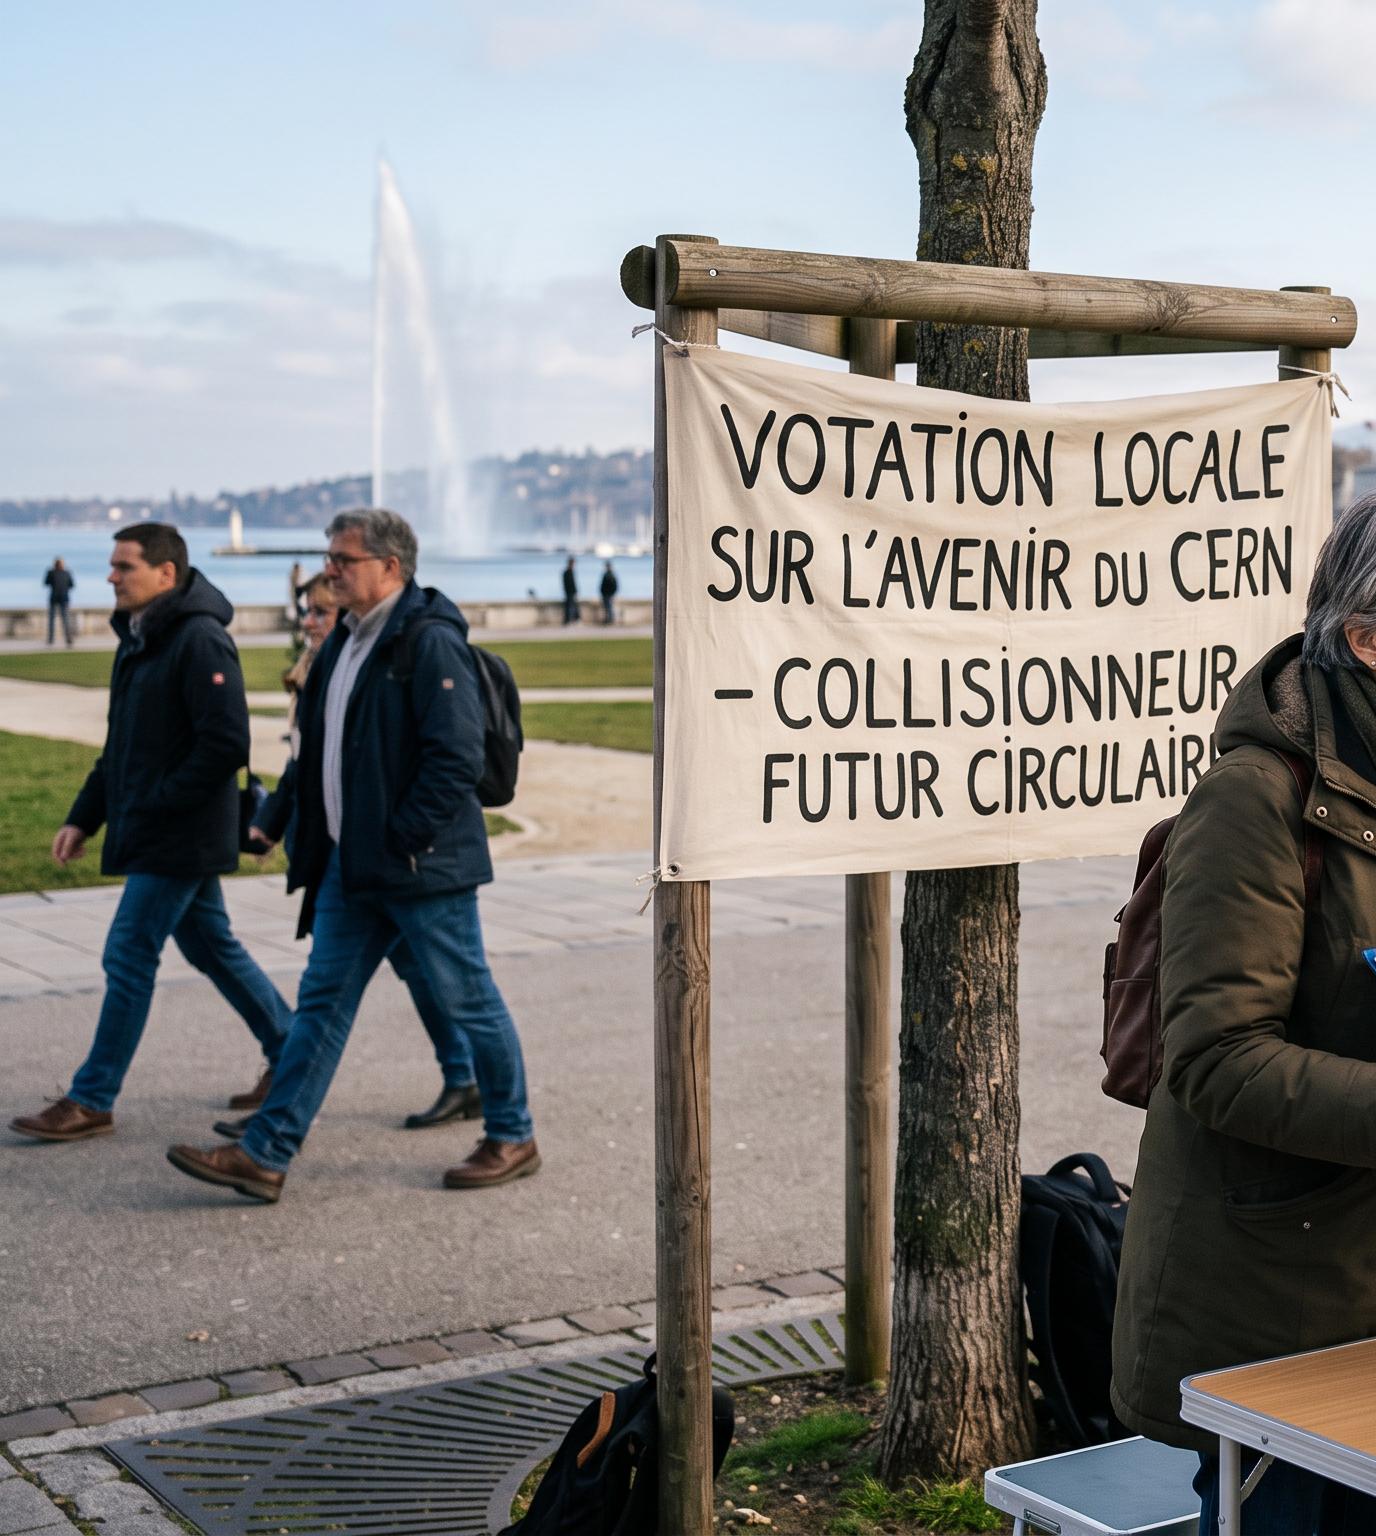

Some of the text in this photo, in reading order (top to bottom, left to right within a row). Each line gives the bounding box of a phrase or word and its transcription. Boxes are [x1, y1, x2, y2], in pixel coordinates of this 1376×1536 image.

[1093, 424, 1291, 508] LOCALE
[707, 525, 815, 605] SUR
[1094, 551, 1148, 608] DU
[1170, 525, 1293, 603] CERN
[762, 750, 944, 824] FUTUR
